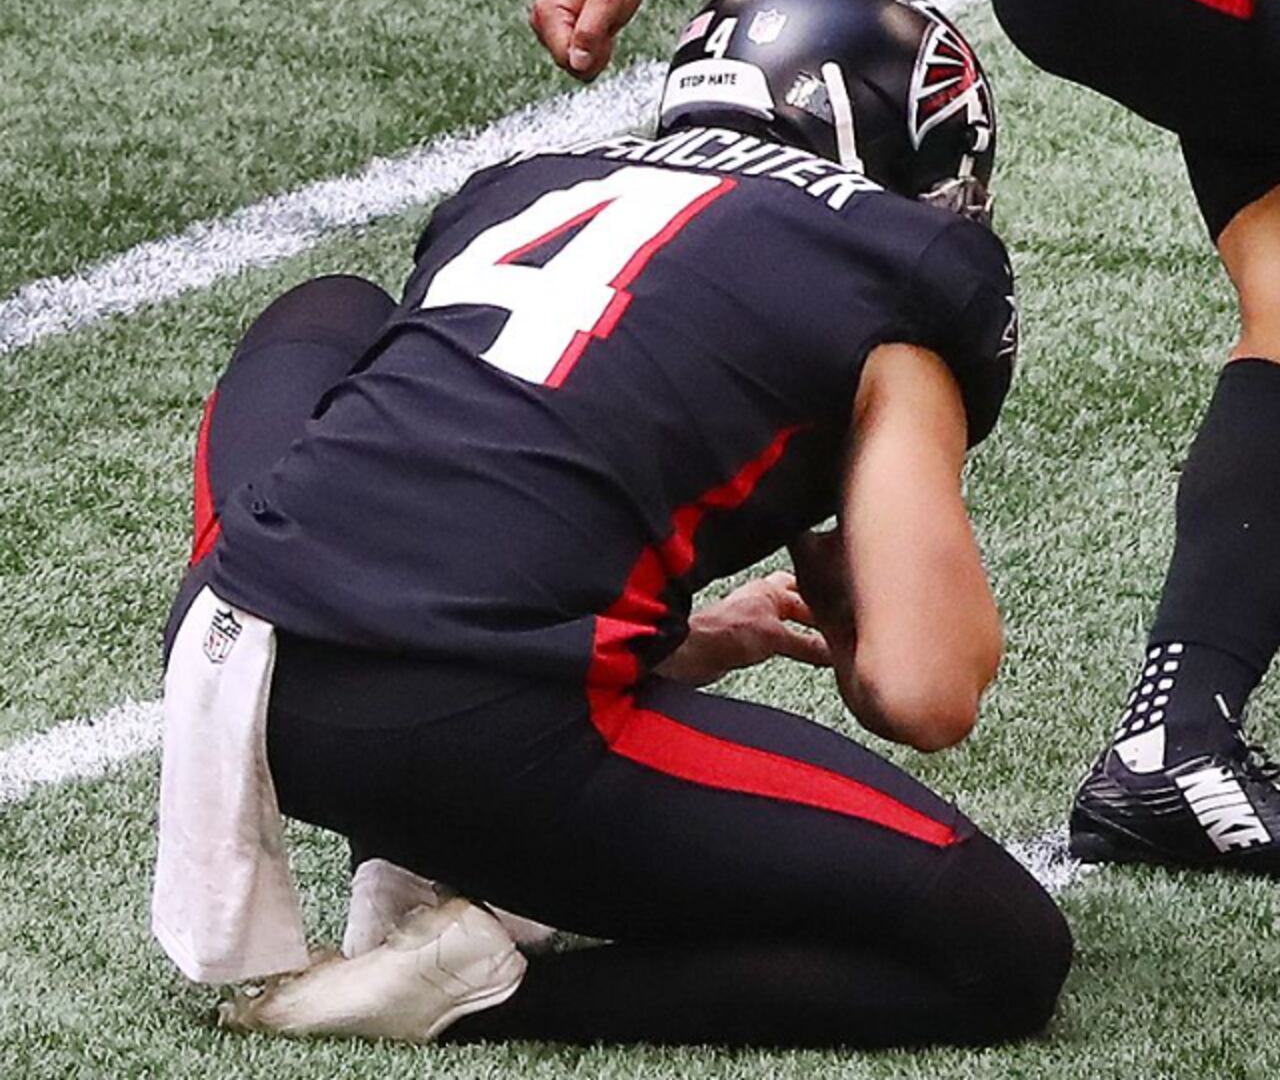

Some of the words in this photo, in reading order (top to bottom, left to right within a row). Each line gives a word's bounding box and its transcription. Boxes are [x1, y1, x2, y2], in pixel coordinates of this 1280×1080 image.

[704, 17, 738, 59] 4
[680, 76, 705, 88] STOP
[708, 73, 738, 86] HATE
[507, 127, 885, 211] RICHTER
[421, 163, 738, 388] 4
[1175, 766, 1272, 853] NIKE
